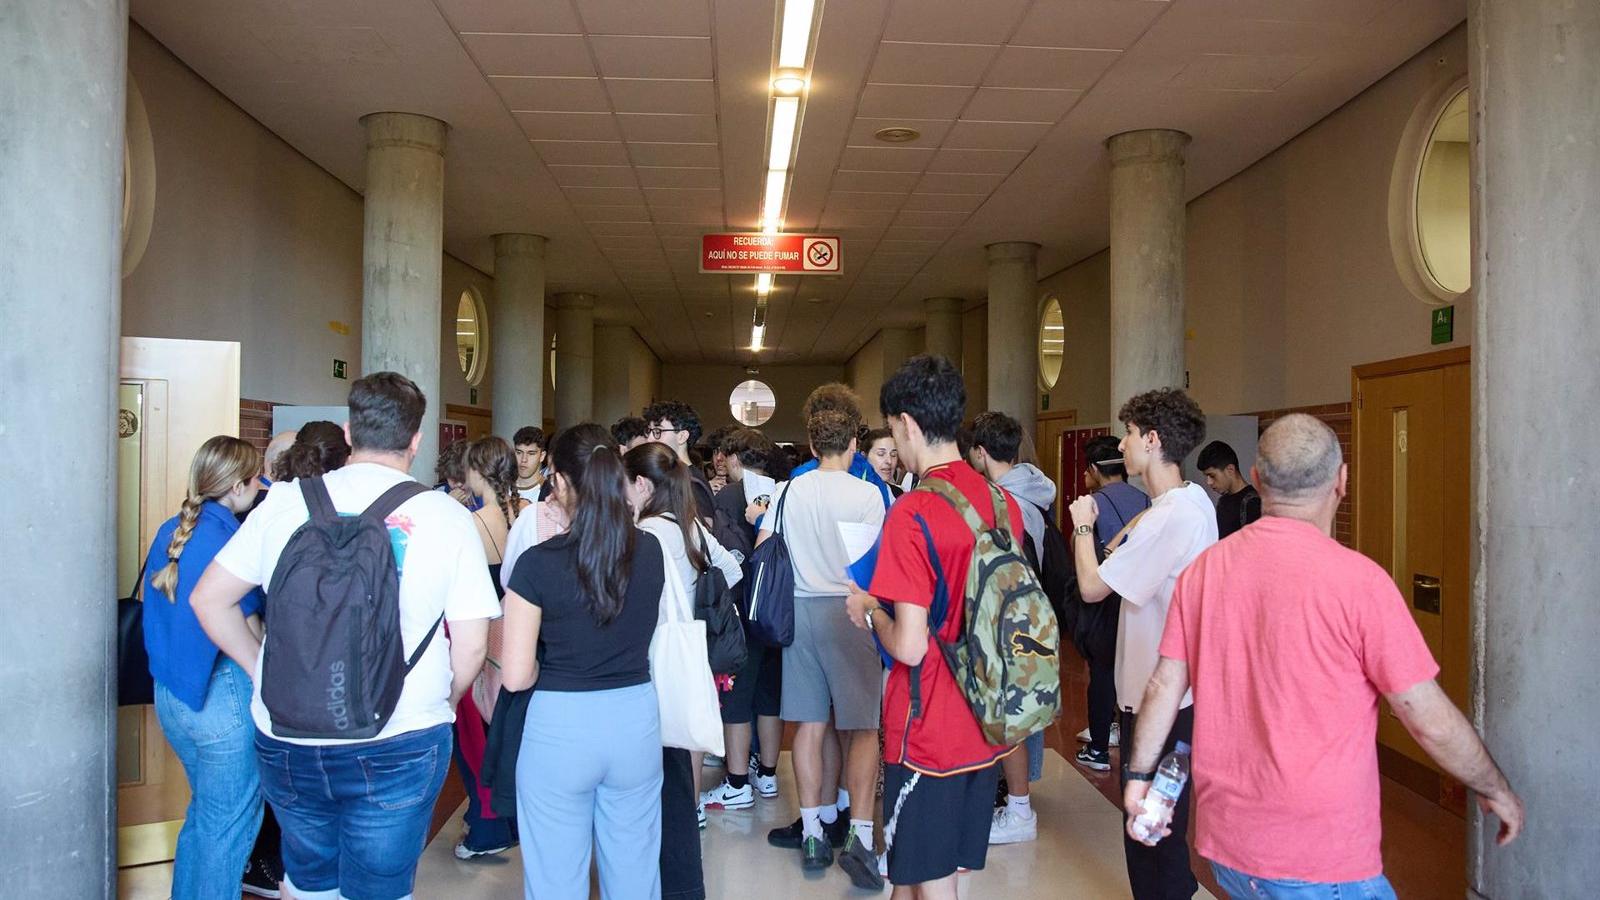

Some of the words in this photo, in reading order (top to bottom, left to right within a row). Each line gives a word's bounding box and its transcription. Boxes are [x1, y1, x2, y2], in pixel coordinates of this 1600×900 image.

[708, 248, 726, 260] AQUÍ
[726, 250, 738, 260] NO
[738, 250, 749, 260] SE
[749, 250, 773, 260] PUEDE
[774, 251, 800, 261] FUMAR
[326, 660, 349, 730] adidas
